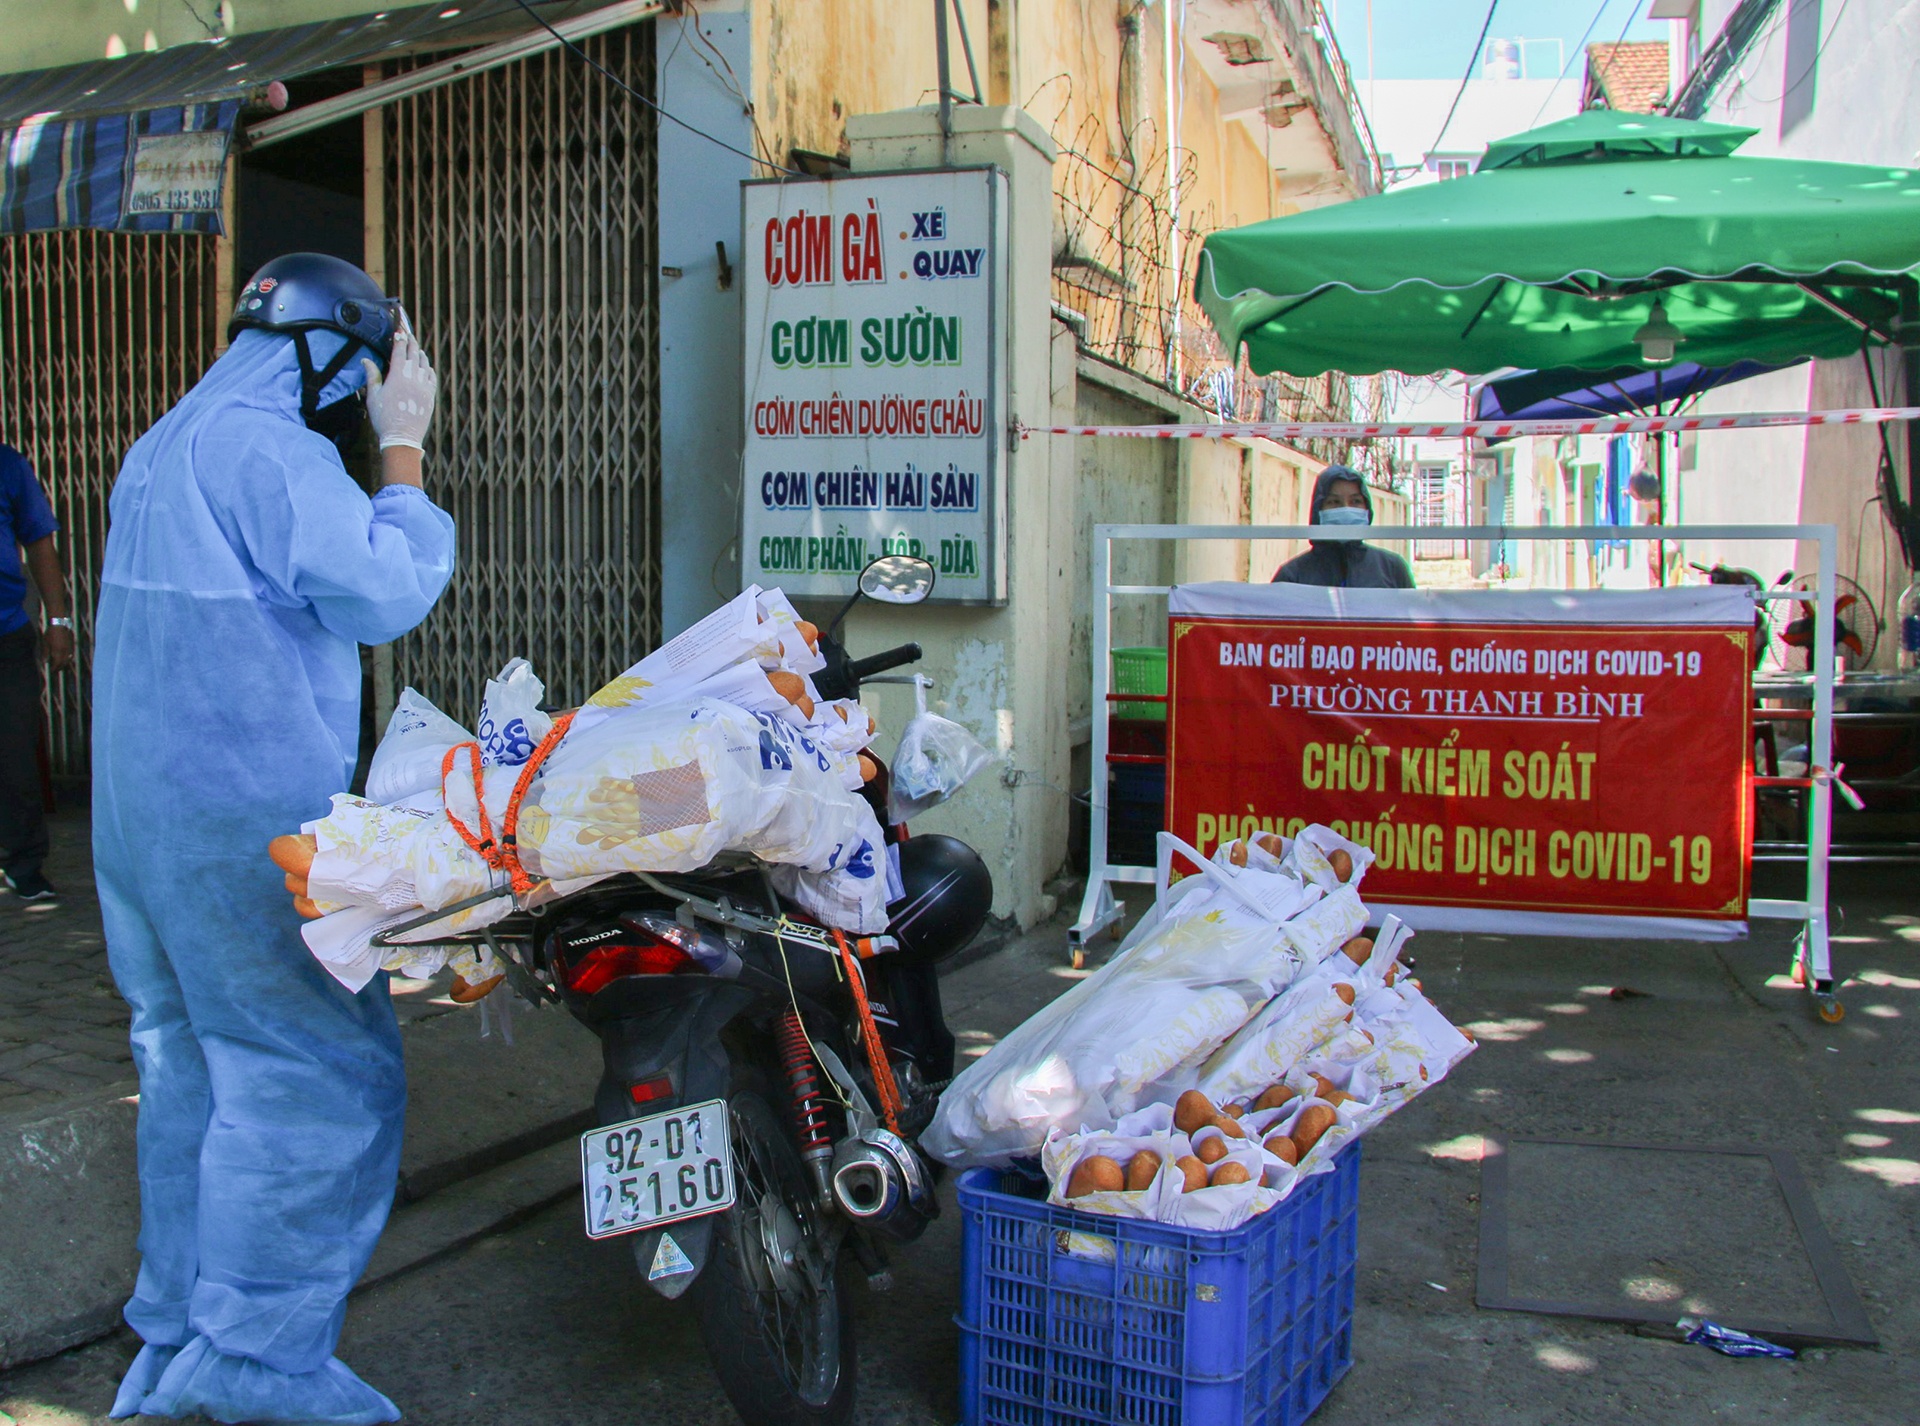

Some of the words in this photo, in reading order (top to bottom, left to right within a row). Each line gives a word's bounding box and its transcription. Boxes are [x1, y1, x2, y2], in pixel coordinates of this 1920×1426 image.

[765, 209, 832, 286] CƠM
[842, 197, 883, 282] GÀ
[912, 207, 944, 238] XÉ
[913, 249, 982, 278] QUAY
[771, 315, 848, 365] CƠM
[861, 306, 958, 363] SƯỜN
[755, 395, 795, 435] CƠM
[800, 391, 852, 435] CHIÊN
[858, 393, 926, 435] DƯƠNG
[930, 389, 983, 434] CHÂU
[761, 471, 808, 506] CƠM
[815, 465, 878, 507] CHIÊN
[886, 462, 923, 507] HẢI
[931, 462, 975, 508] SẢN
[808, 524, 863, 571] PHẦN
[1219, 641, 1263, 667] BAN
[1269, 637, 1306, 669] CHỈ
[1311, 645, 1355, 675] ĐẠO
[1361, 641, 1444, 675] PHÒNG,
[1450, 640, 1528, 674] CHỐNG
[1533, 650, 1588, 680] DỊCH
[1595, 651, 1702, 677] COVID-19
[1269, 678, 1412, 712] PHƯỜNG
[1421, 688, 1544, 715] THANH
[1553, 685, 1645, 717] BÌNH
[1302, 728, 1391, 792] CHỐT
[1401, 728, 1491, 797] KIỂM
[1502, 741, 1597, 800] SOÁT
[1455, 825, 1537, 885] DỊCH
[1549, 830, 1712, 885] COVID-19
[568, 929, 623, 947] HONDA
[605, 1111, 703, 1175] 92-D1
[595, 1158, 725, 1229] 251.60
